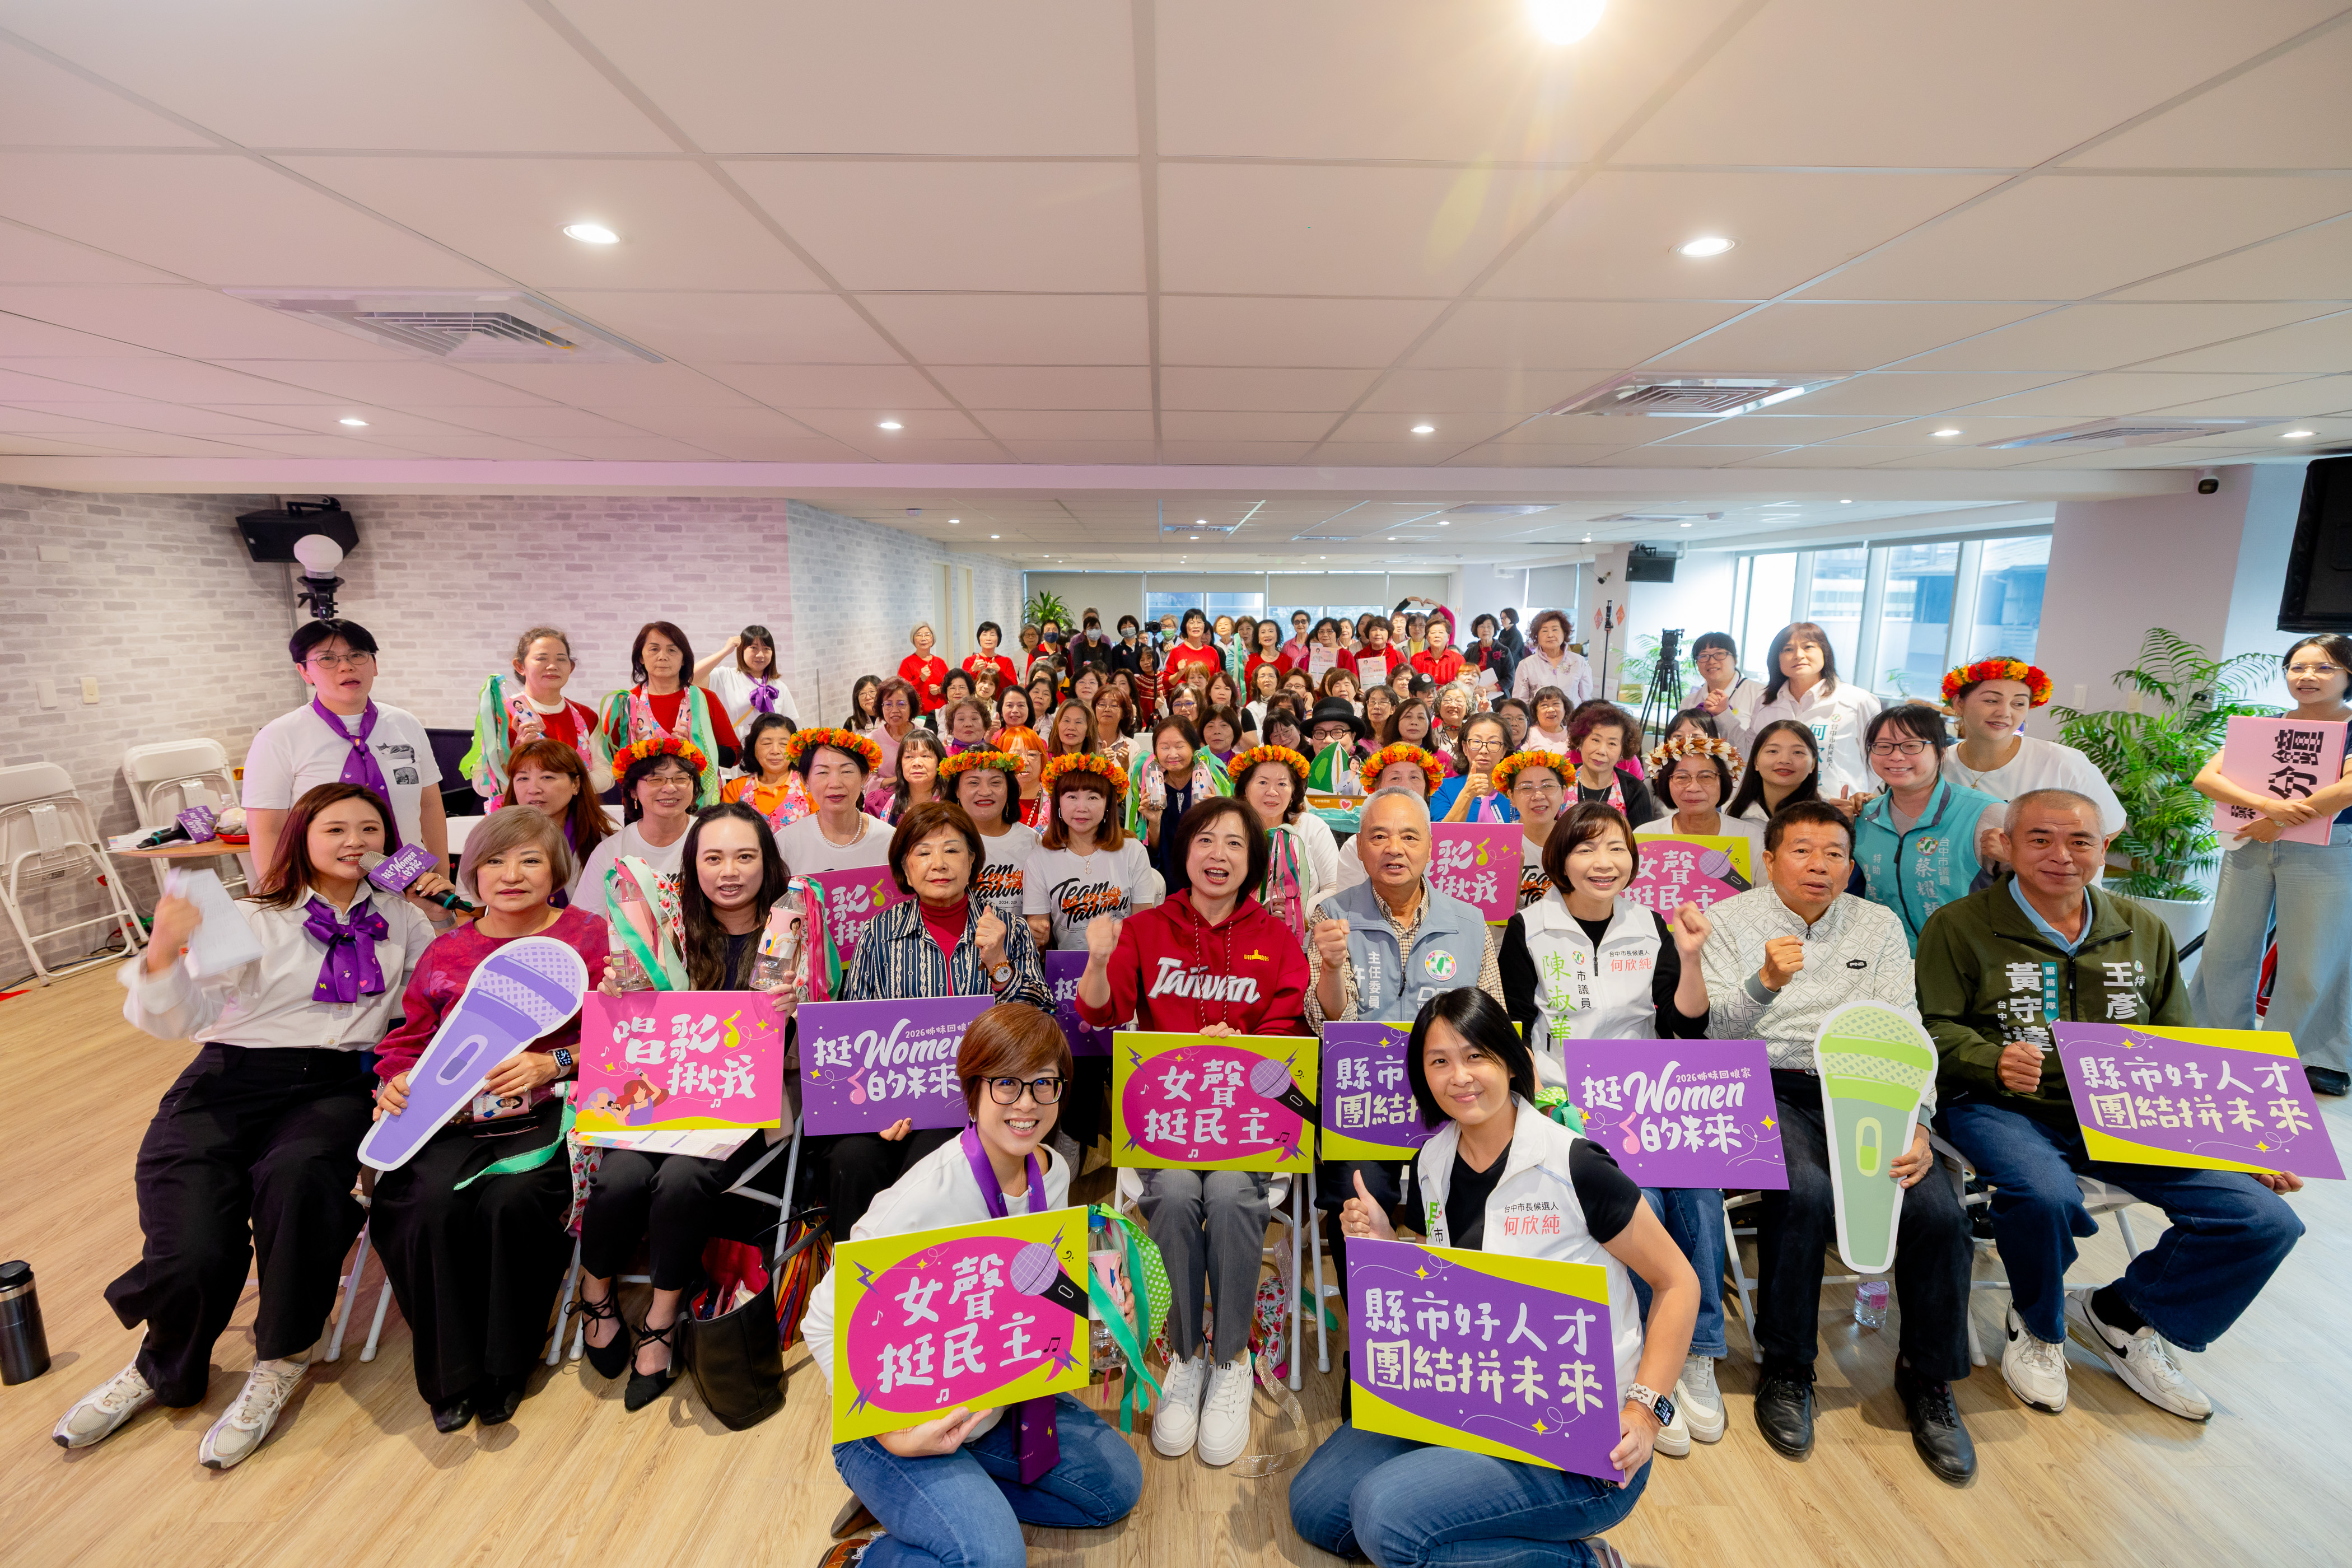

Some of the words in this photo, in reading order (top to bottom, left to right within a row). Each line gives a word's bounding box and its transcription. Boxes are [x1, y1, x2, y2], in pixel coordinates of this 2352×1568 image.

[1873, 853, 1882, 875] 特助
[1938, 837, 1950, 885] 台中市議員
[1147, 956, 1262, 1004] Taiwan
[1368, 951, 1381, 1009] 主任委員
[1611, 957, 1653, 972] 何欣純
[1542, 950, 1577, 1048] 陳淑華
[1577, 970, 1592, 1009] 市議員
[2045, 967, 2056, 1010] 服務團隊
[613, 1014, 720, 1065] 唱歌
[666, 1054, 756, 1099] 揪我
[867, 1062, 962, 1101] 的未來
[1158, 1058, 1245, 1108] 女聲
[1336, 1054, 1404, 1090] 縣市
[1676, 1067, 1752, 1083] 2026姊妹回娘家
[2079, 1056, 2290, 1095] 縣市好人才
[1144, 1108, 1274, 1145] 挺民主
[1640, 1113, 1743, 1154] 的未來
[2089, 1092, 2313, 1136] 團結拼未來
[1504, 1202, 1559, 1213] 台中市長候選人
[1504, 1214, 1560, 1236] 何欣純
[894, 1253, 1004, 1326] 女聲
[1365, 1287, 1596, 1356] 縣市好人才
[877, 1312, 1042, 1393] 挺民主
[1366, 1338, 1603, 1415] 團結拼未來
